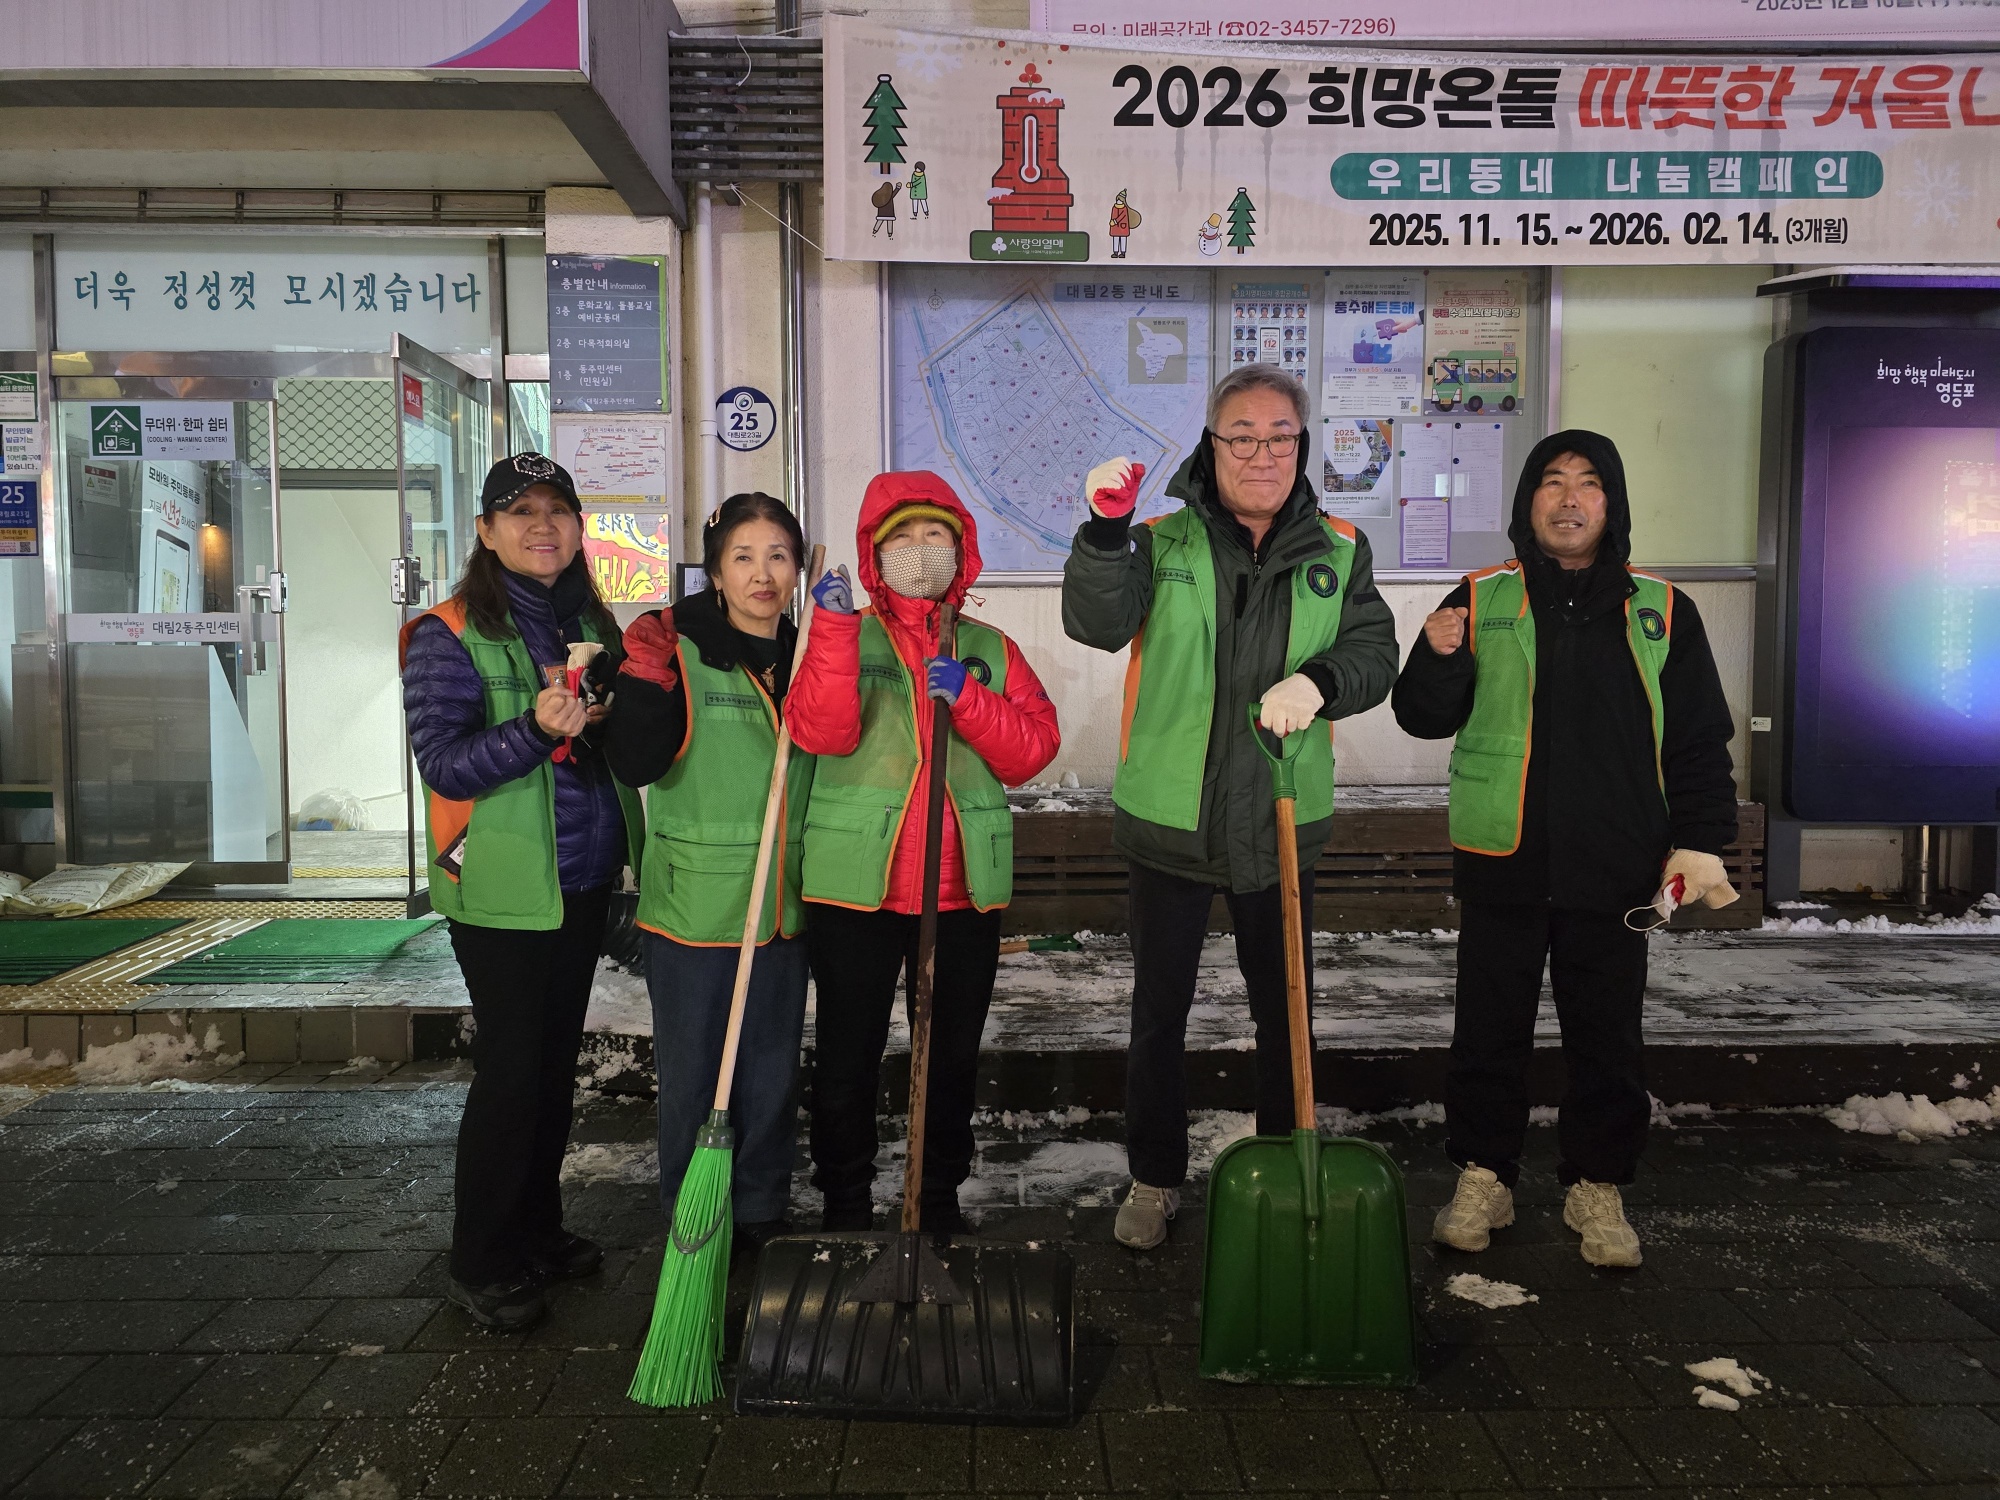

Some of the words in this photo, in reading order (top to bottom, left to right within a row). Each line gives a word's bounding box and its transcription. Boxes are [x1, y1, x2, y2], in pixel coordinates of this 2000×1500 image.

[1112, 65, 1287, 128] 2026
[1307, 66, 1562, 128] 희망온돌
[1578, 65, 1796, 130] 따뜻한
[1367, 158, 1553, 194] 우리동네
[1606, 157, 1848, 194] 나눔캠페인
[1369, 213, 1449, 246] 2025.
[1458, 213, 1500, 246] 11.
[1683, 212, 1728, 245] 02.
[1737, 212, 1779, 244] 14.
[1785, 217, 1849, 244] (3개월)
[1009, 238, 1064, 250] 사랑의열매
[561, 277, 609, 291] 층별안내
[74, 270, 136, 311] 더욱
[163, 270, 256, 311] 정성껏
[284, 272, 482, 313] 모시겠습니다
[1066, 285, 1126, 299] 대림2동
[1132, 285, 1180, 299] 관내도
[555, 305, 571, 317] 3층
[556, 338, 571, 349] 2층
[578, 339, 630, 349] 다목적회의실
[1263, 340, 1277, 348] 112
[557, 370, 573, 381] 1층
[578, 364, 623, 374] 동주민센터
[1877, 359, 1902, 385] 희망
[1904, 364, 1927, 388] 행복
[1930, 356, 1975, 380] 미래도시
[580, 376, 612, 387] (민원실)
[1935, 383, 1975, 408] 영등포
[207, 417, 228, 432] 쉼터
[730, 413, 759, 431] 25
[2, 485, 25, 504] 25
[152, 621, 240, 635] 대림2동주민센터
